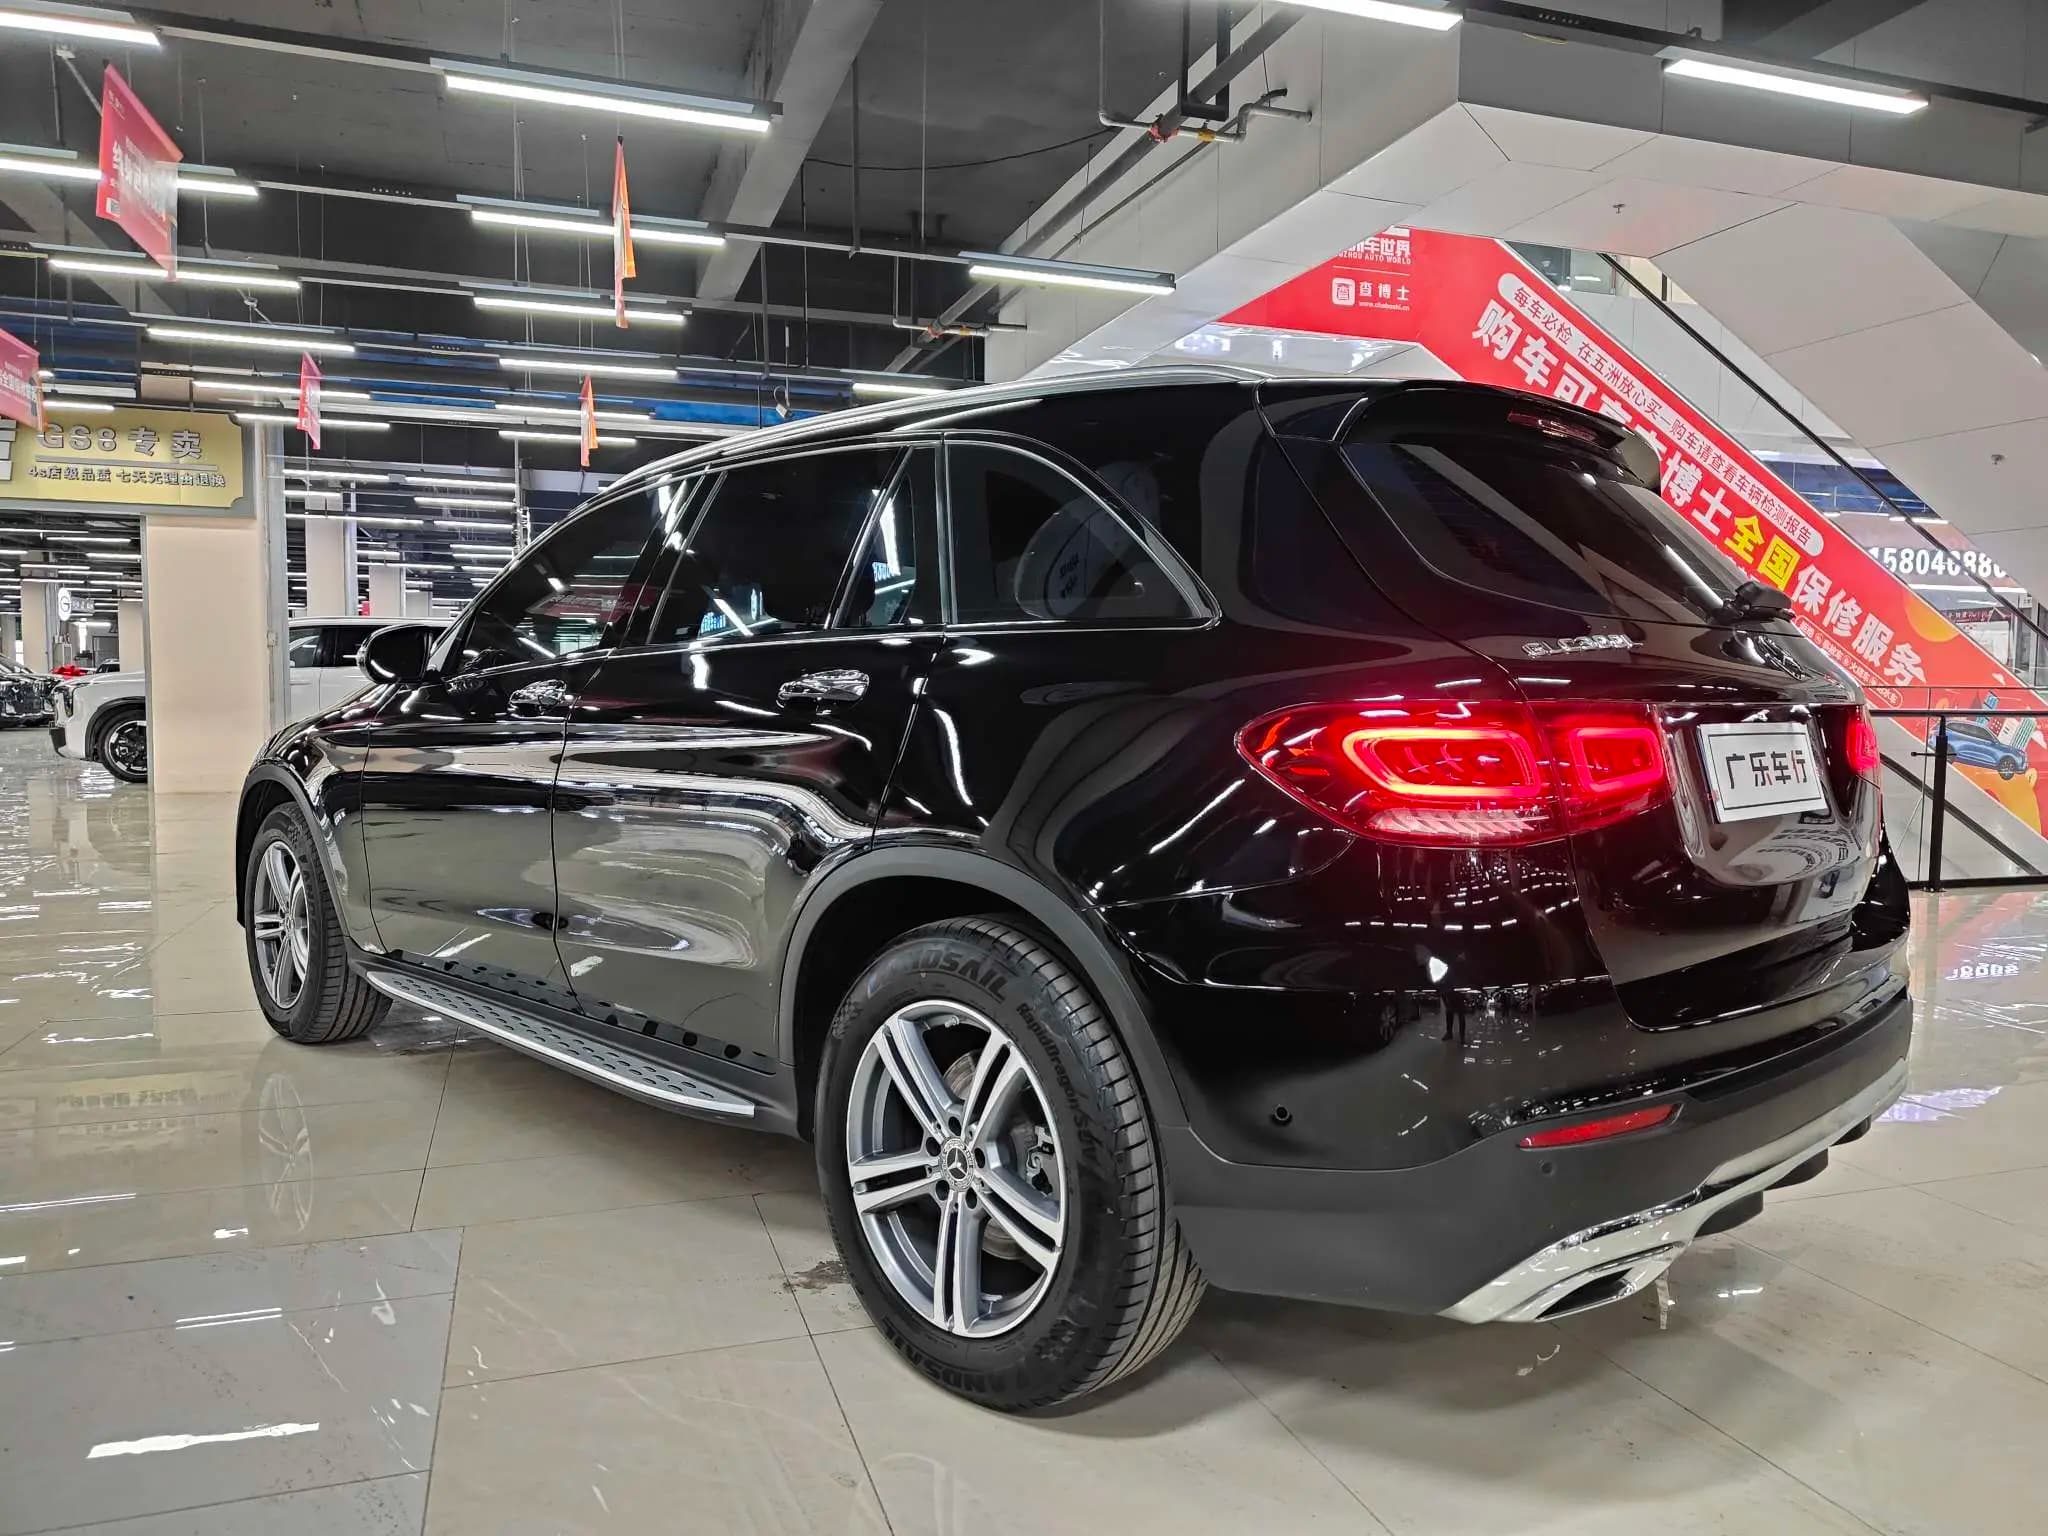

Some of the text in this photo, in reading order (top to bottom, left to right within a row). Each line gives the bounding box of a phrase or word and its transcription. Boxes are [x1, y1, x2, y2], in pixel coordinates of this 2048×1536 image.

[1364, 253, 1384, 262] AUTO
[1386, 255, 1411, 265] WORLD
[1359, 281, 1410, 301] 查博士
[1514, 287, 1573, 344] 每车必检
[128, 426, 202, 459] 专卖
[1725, 748, 1809, 790] 广乐车行
